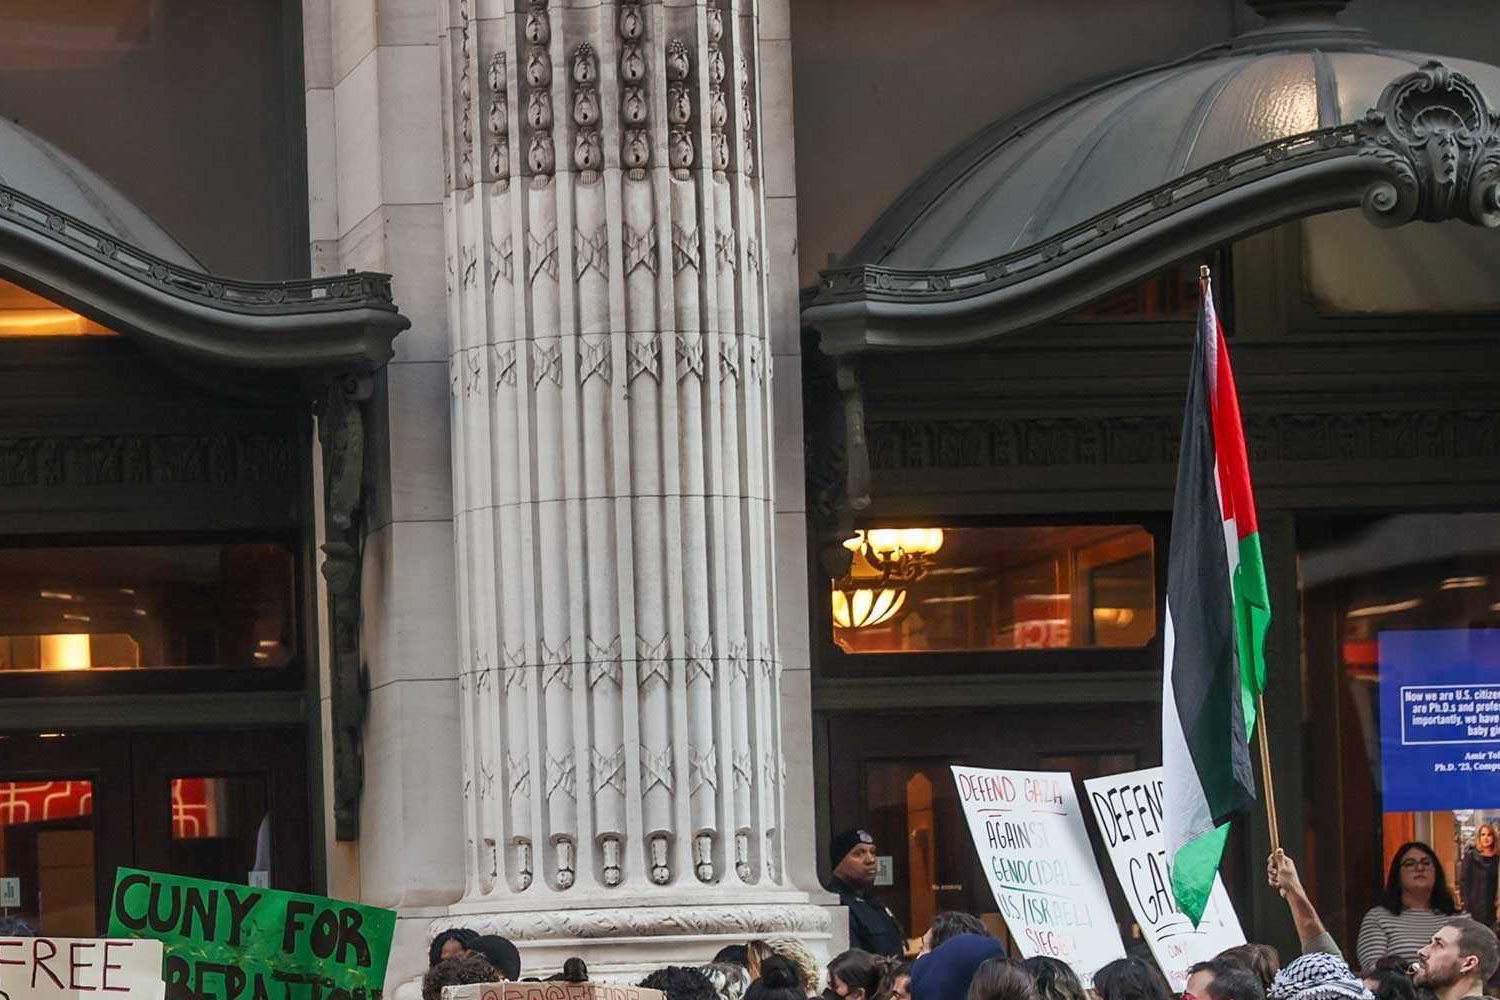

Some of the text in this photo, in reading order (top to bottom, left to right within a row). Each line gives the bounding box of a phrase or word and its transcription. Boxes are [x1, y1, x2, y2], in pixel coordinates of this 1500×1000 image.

[1405, 691, 1424, 702] Now
[1425, 693, 1438, 701] we
[1439, 693, 1454, 701] are
[1456, 690, 1472, 700] U.S.
[1412, 704, 1427, 714] are
[1458, 702, 1474, 712] and
[1464, 716, 1477, 724] we
[1479, 714, 1500, 723] have
[1467, 725, 1488, 737] baby
[958, 774, 1063, 805] DEFEND GAZA
[985, 820, 1053, 850] AGAINST
[991, 855, 1082, 888] GENOCIDAL
[115, 873, 372, 969] CUNY FOR
